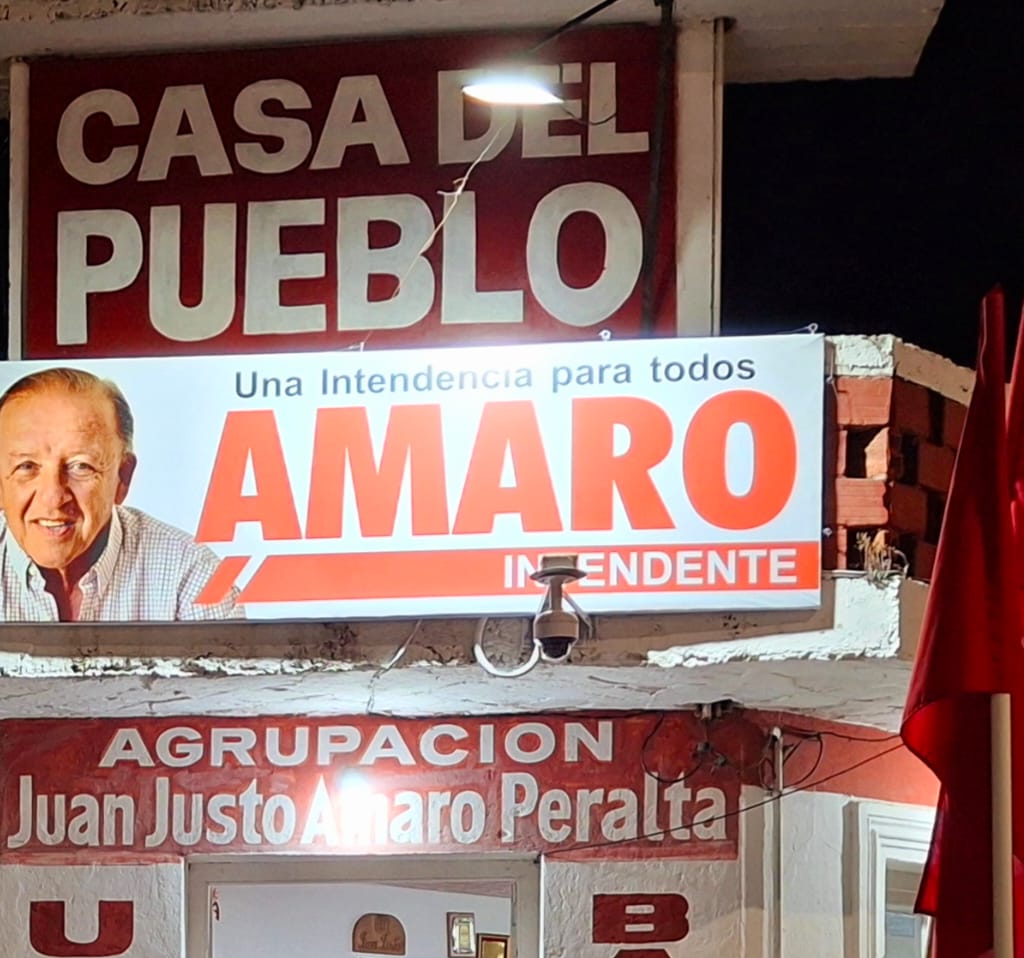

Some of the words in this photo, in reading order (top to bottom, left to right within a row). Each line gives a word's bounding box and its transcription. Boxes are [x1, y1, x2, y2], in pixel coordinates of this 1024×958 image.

[57, 75, 408, 186] CASA
[437, 62, 650, 166] DEL
[57, 182, 643, 346] PUEBLO
[234, 370, 303, 400] Una
[320, 363, 533, 396] Intendencia
[552, 360, 635, 396] para
[649, 354, 756, 383] todos
[195, 389, 798, 543] AMARO
[504, 548, 798, 588] INENDENTE
[98, 721, 614, 769] AGRUPACION
[7, 775, 135, 848] Juan
[146, 773, 296, 847] Justo
[500, 770, 727, 846] Peralta
